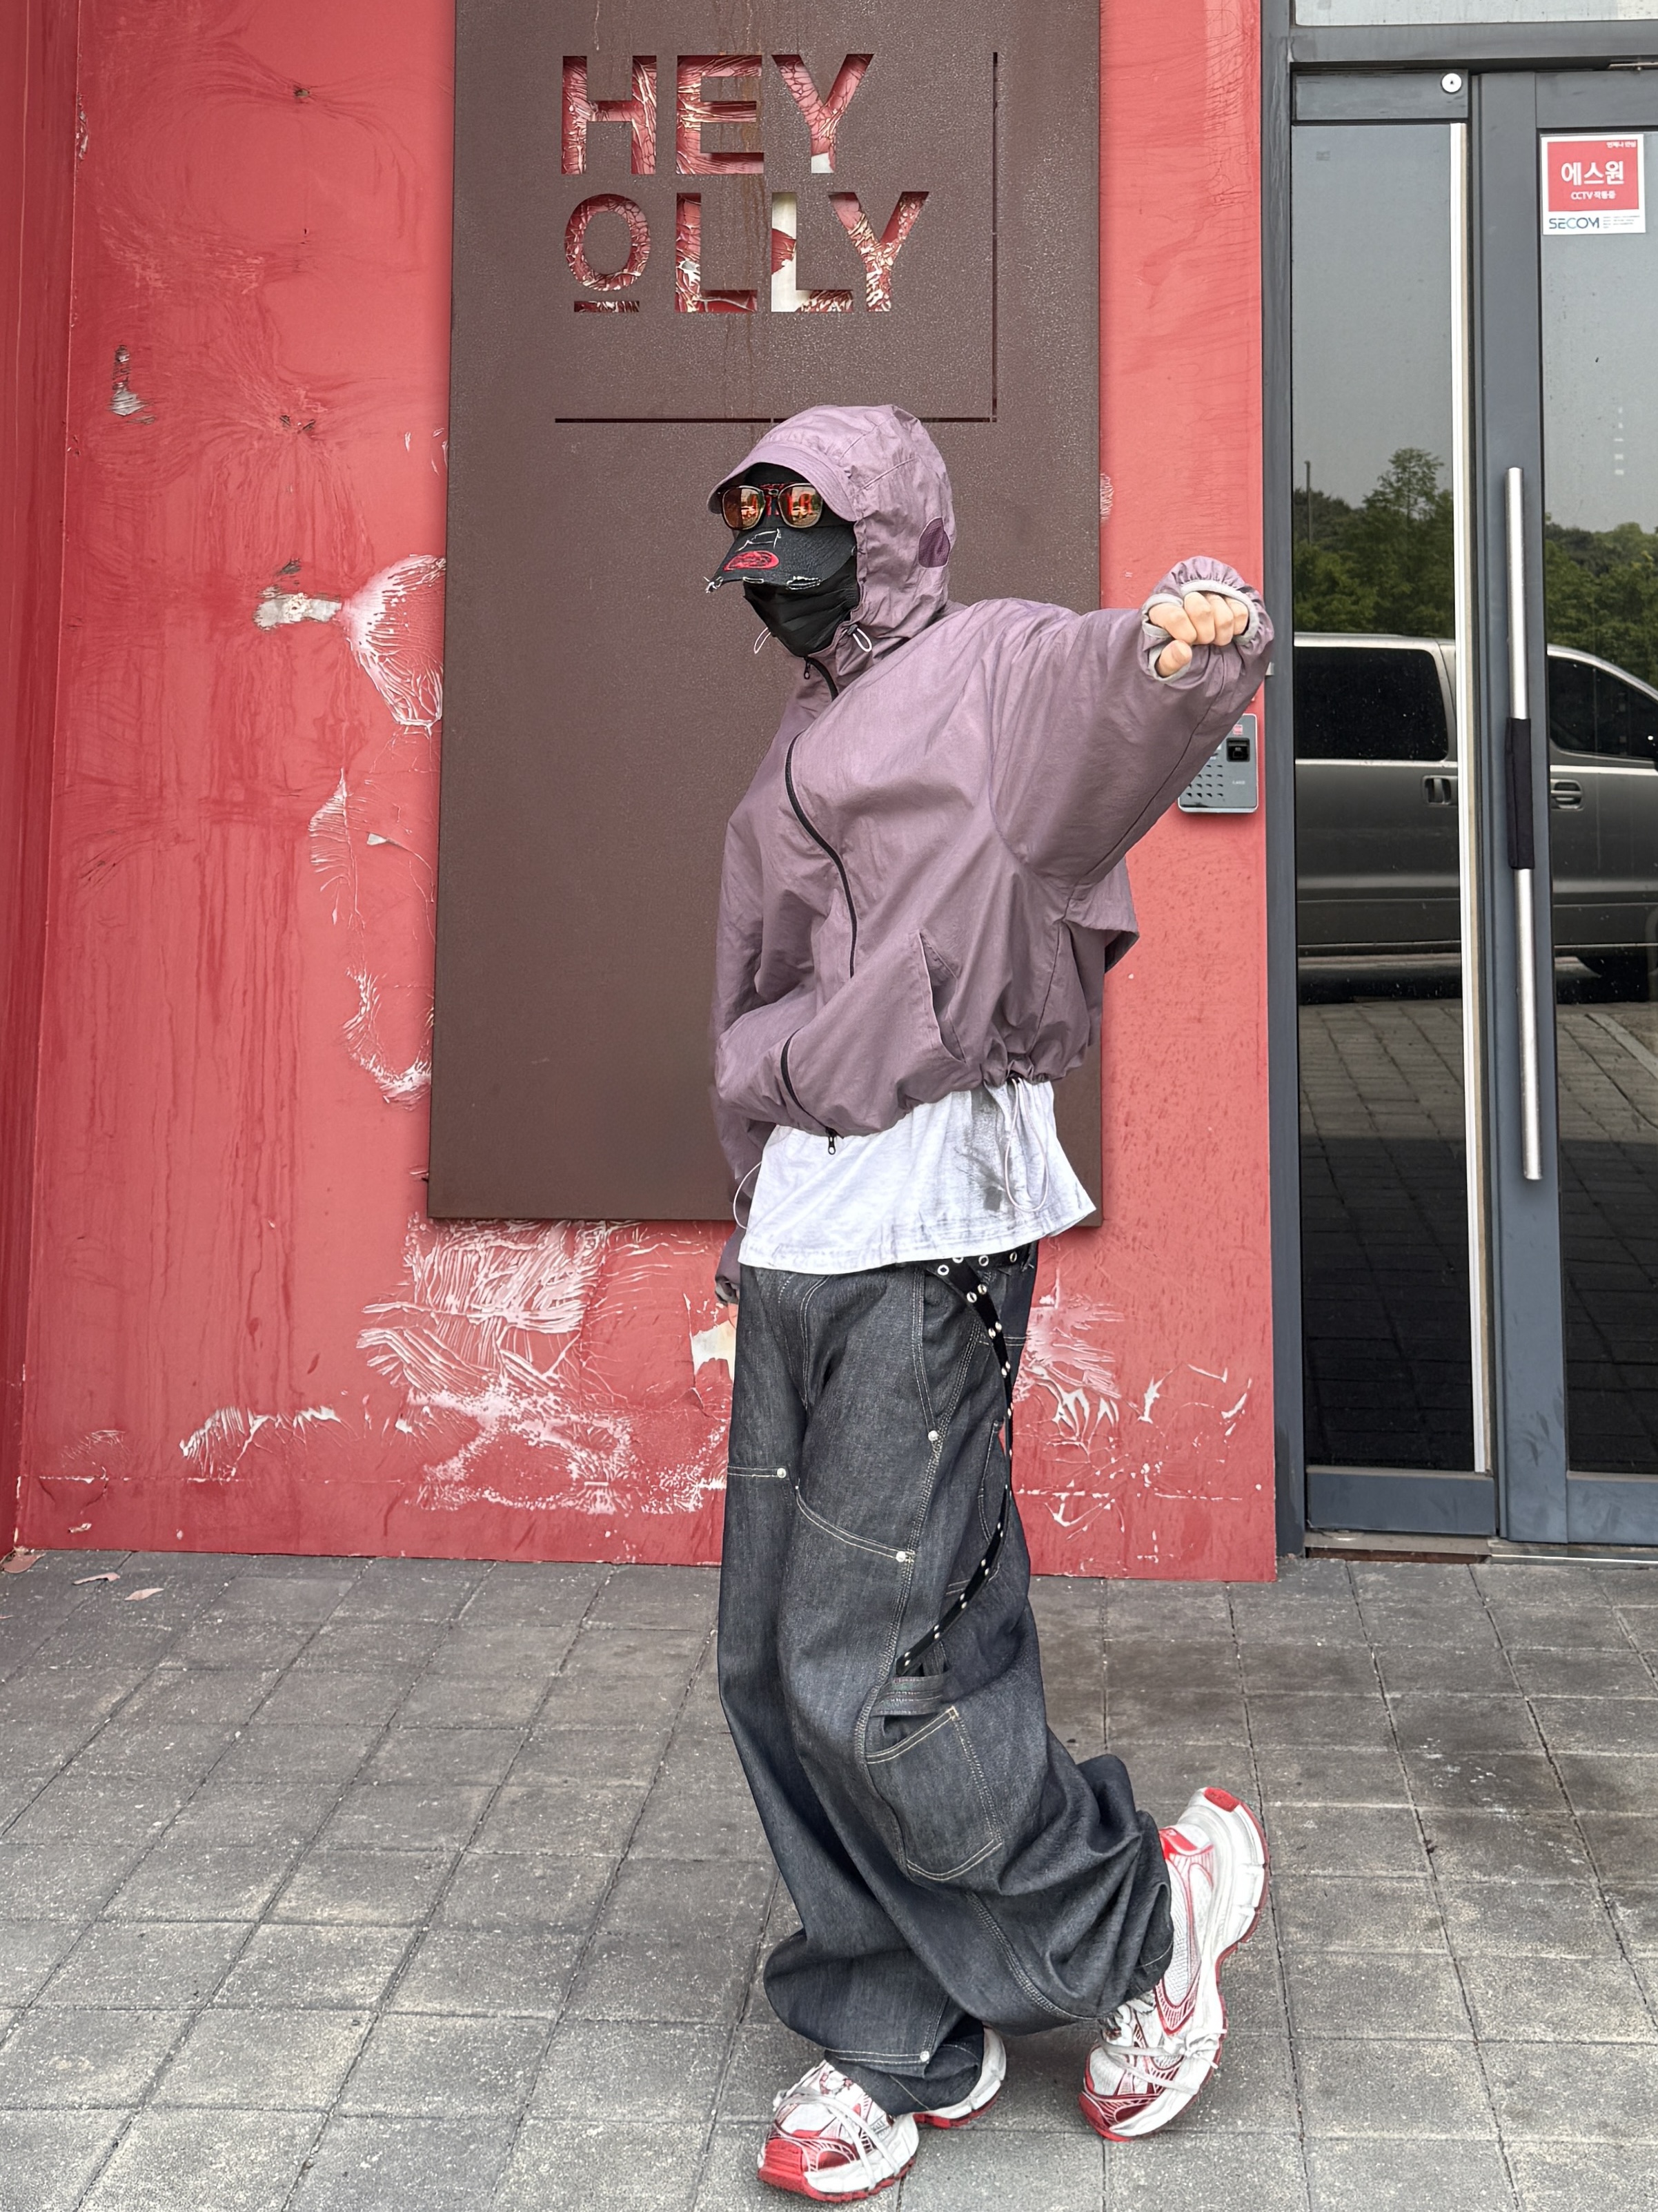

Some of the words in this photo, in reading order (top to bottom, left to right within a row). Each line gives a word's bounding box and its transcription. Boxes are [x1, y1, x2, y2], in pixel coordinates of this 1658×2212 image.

[560, 53, 875, 175] HEY
[1561, 161, 1624, 186] 에스원
[1570, 191, 1593, 200] CCTV
[1548, 217, 1599, 230] SECOM
[564, 190, 930, 313] OLLY
